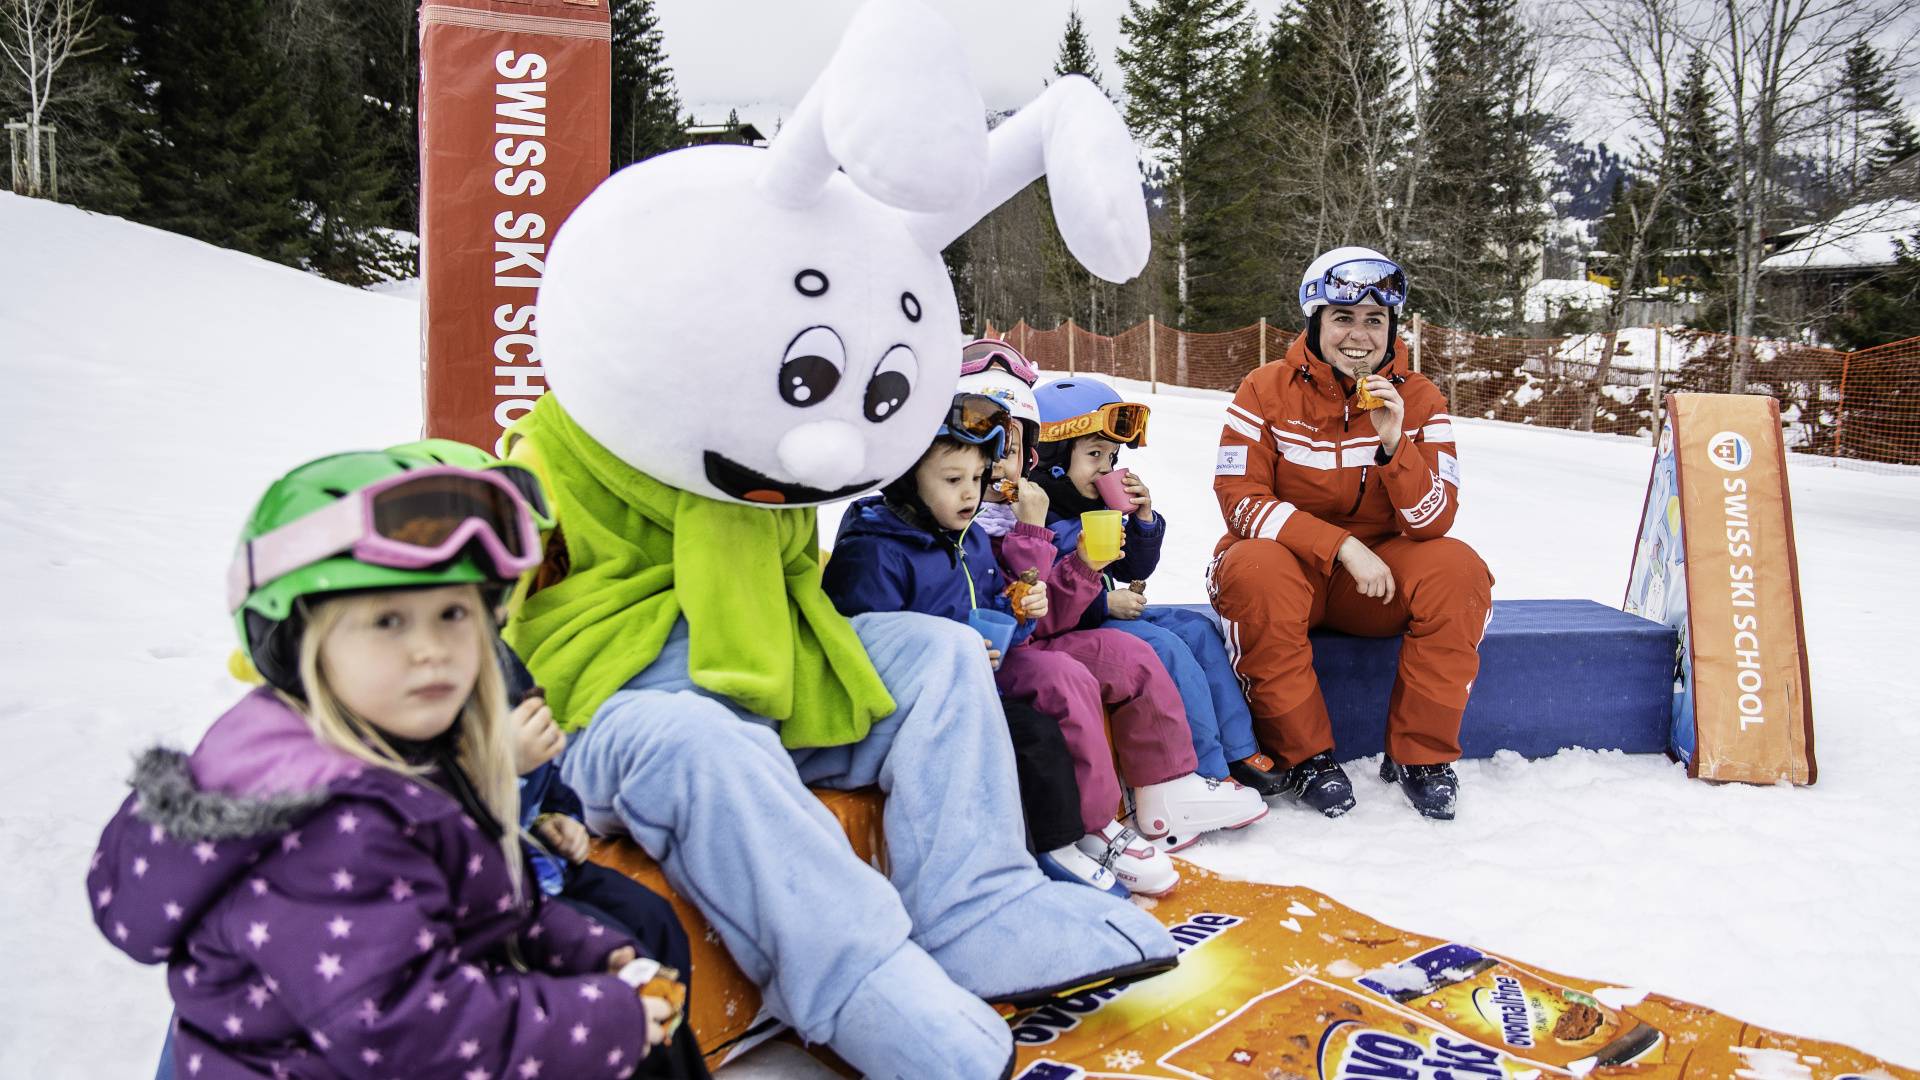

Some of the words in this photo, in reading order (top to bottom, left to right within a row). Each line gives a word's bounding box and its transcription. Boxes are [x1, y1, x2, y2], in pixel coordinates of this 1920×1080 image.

[495, 50, 547, 196] SWISS
[494, 211, 546, 288] SKI
[494, 303, 545, 459] SCHO
[1048, 416, 1090, 437] GIRO
[1723, 478, 1752, 557] SWISS
[1730, 565, 1755, 607] SKI
[1733, 614, 1764, 731] SCHOOL
